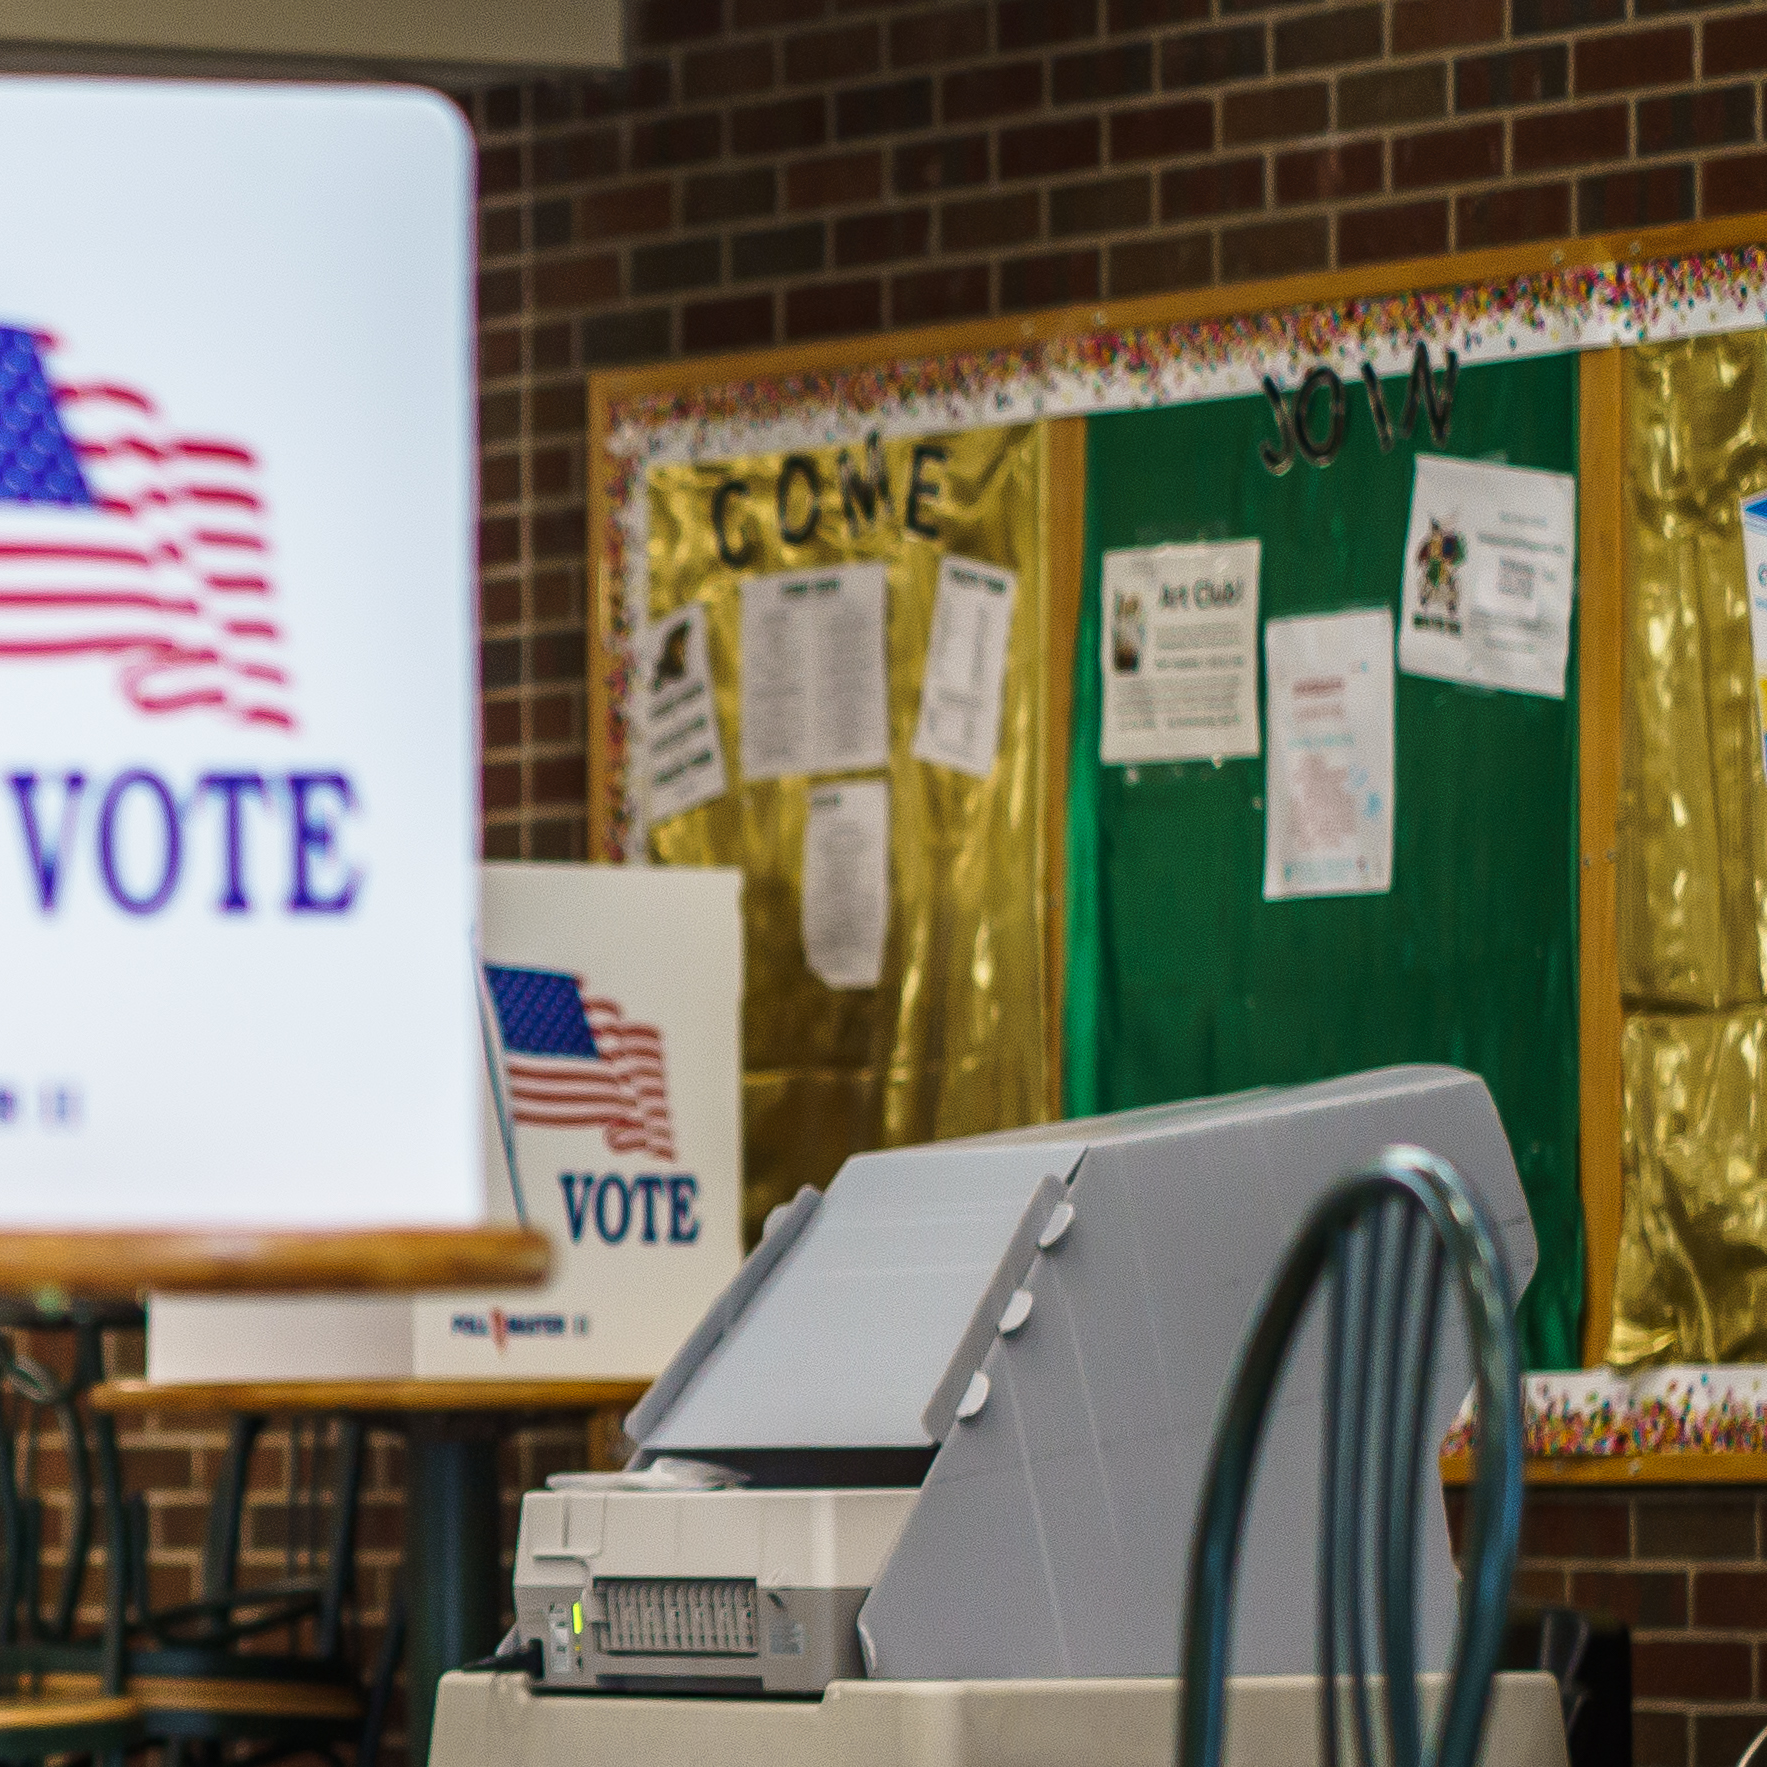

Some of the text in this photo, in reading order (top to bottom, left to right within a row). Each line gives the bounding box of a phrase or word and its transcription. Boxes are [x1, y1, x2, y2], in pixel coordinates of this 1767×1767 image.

[1260, 341, 1460, 475] JOIN
[712, 430, 946, 567] COME
[3, 764, 366, 920] VOTE
[559, 1174, 700, 1244] VOTE
